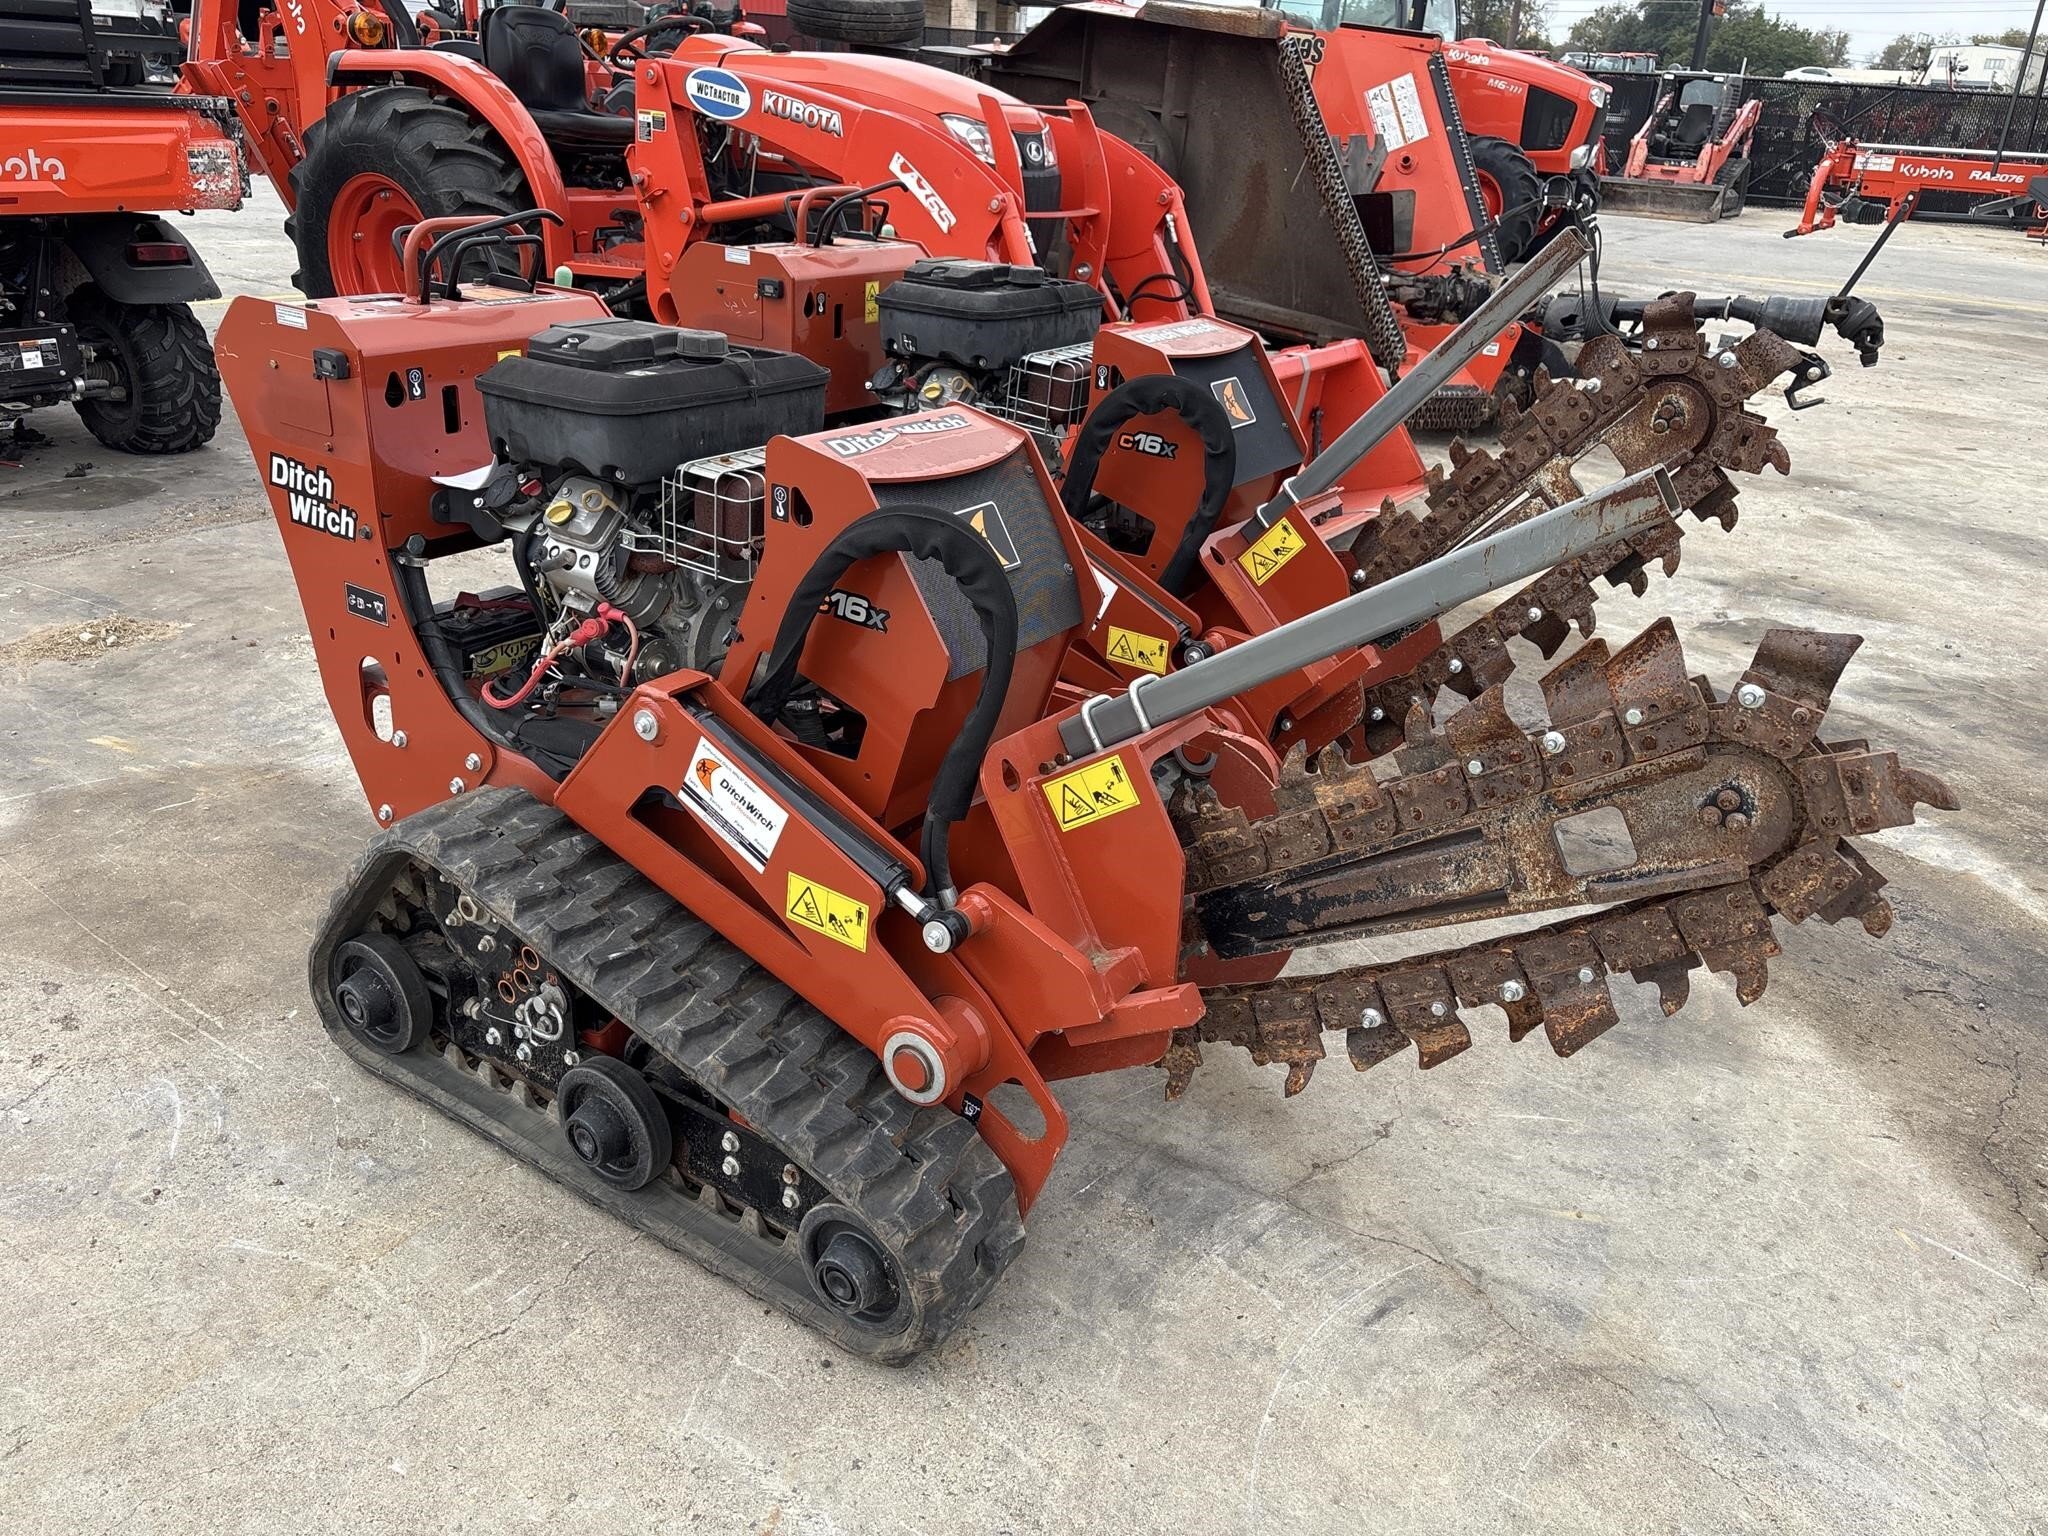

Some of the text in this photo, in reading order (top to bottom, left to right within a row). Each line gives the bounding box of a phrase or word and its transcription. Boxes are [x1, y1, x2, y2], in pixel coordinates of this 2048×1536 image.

[1447, 48, 1490, 66] Kubota
[762, 89, 844, 138] KUBOTA
[0, 148, 66, 181] ota
[1899, 162, 1954, 180] Kubota
[1968, 170, 2026, 184] RA2076
[271, 455, 333, 500] Ditch
[289, 491, 356, 539] Witch
